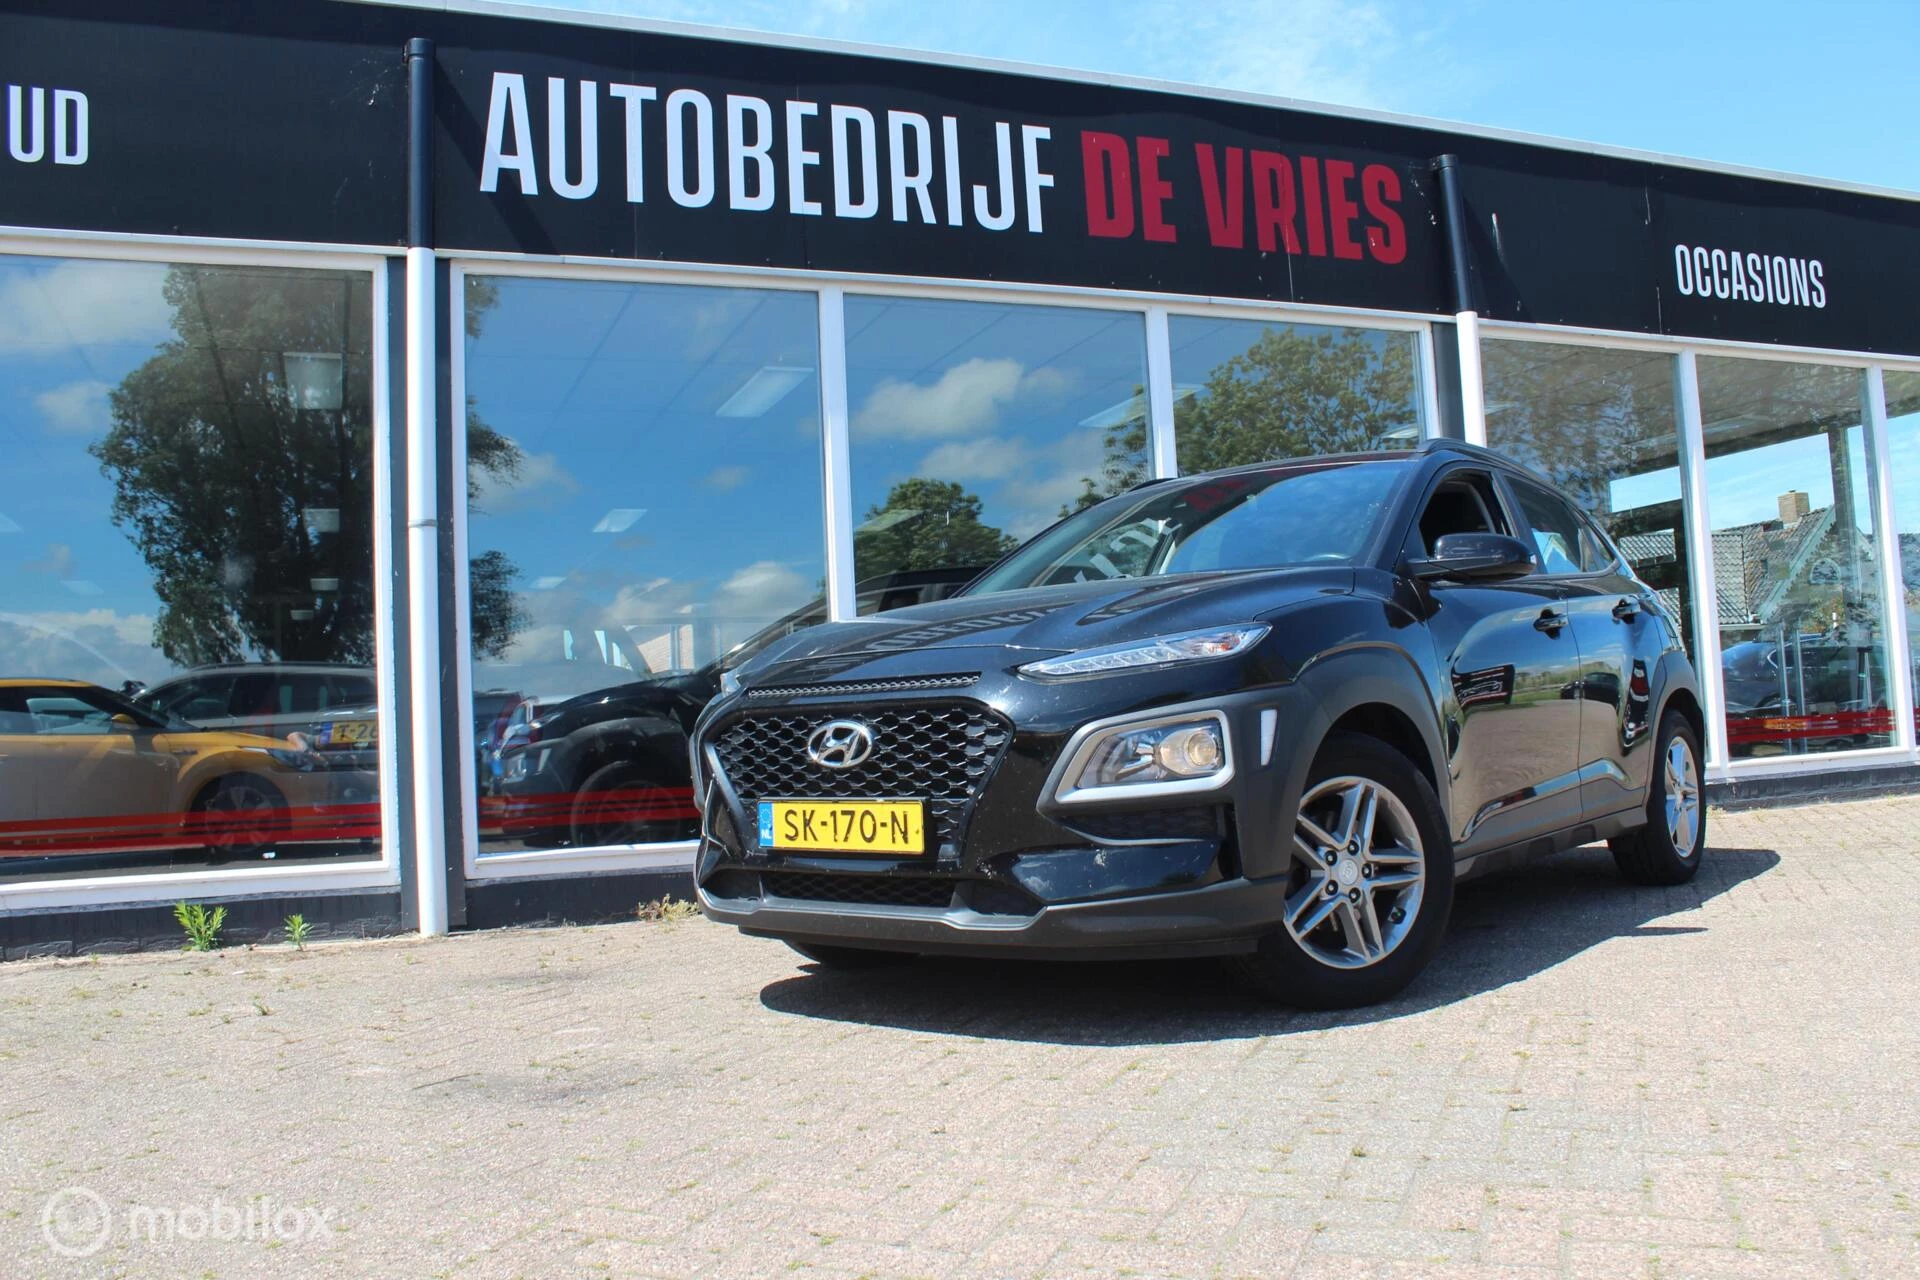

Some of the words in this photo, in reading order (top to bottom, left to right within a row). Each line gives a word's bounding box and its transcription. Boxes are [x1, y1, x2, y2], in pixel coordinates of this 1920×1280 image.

[8, 84, 89, 166] UD
[479, 71, 1056, 234] AUTOBEDRIJF
[1080, 129, 1178, 244] DE
[1194, 142, 1408, 265] VRIES
[1674, 244, 1827, 309] OCCASIONS
[784, 808, 909, 845] SK-170-N
